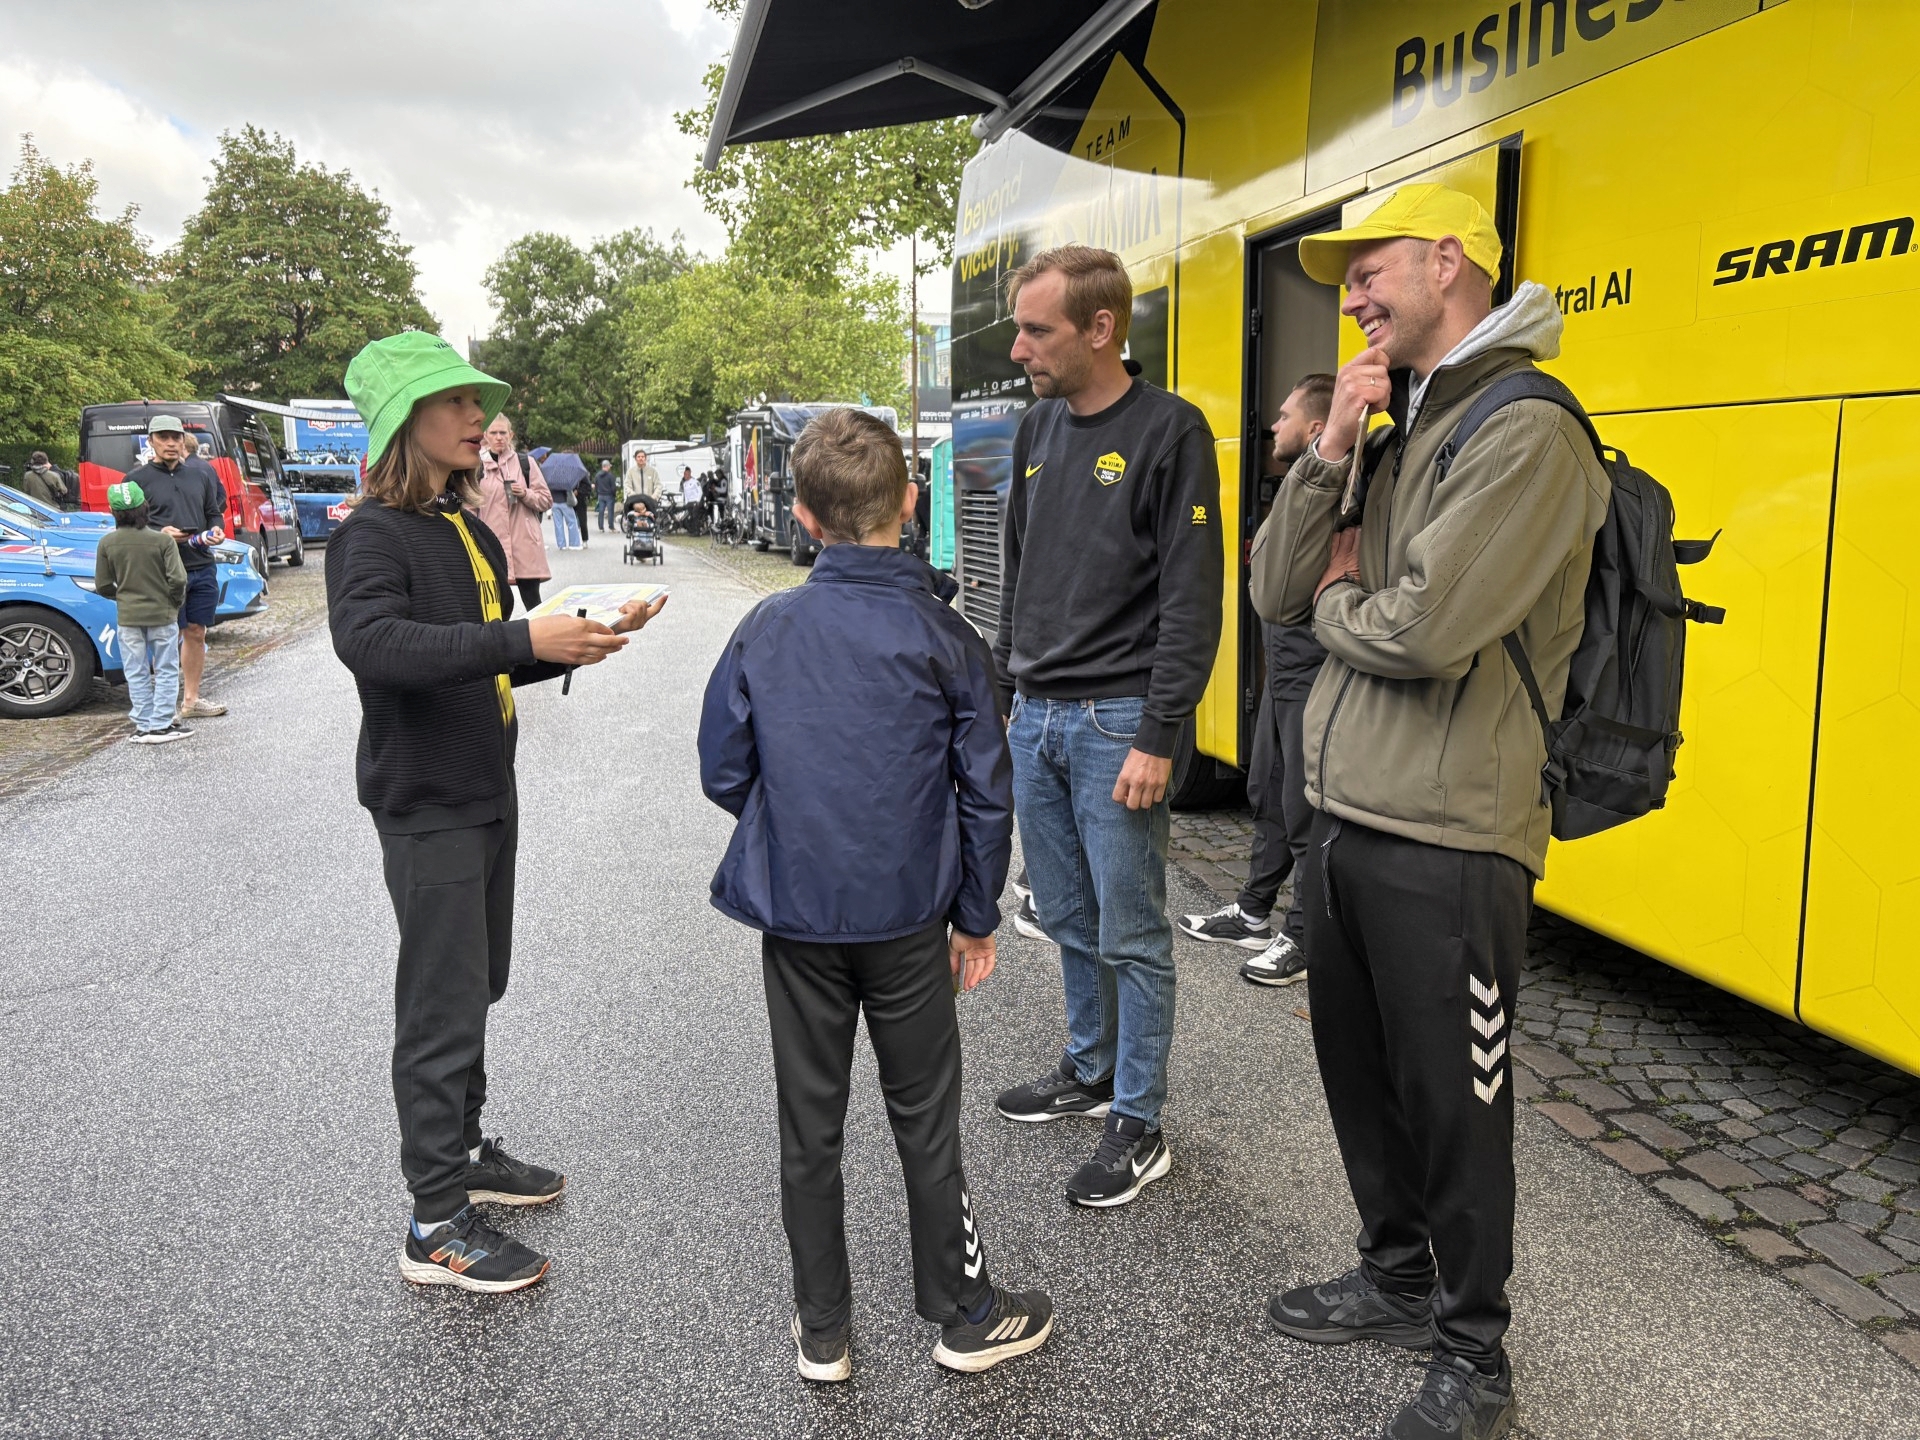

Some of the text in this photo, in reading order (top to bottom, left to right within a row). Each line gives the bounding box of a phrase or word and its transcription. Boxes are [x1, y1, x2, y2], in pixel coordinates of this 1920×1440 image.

[1391, 0, 1690, 129] Busine
[1086, 115, 1132, 161] TEAM
[963, 161, 1023, 237] beyond
[1555, 268, 1632, 316] tral AI
